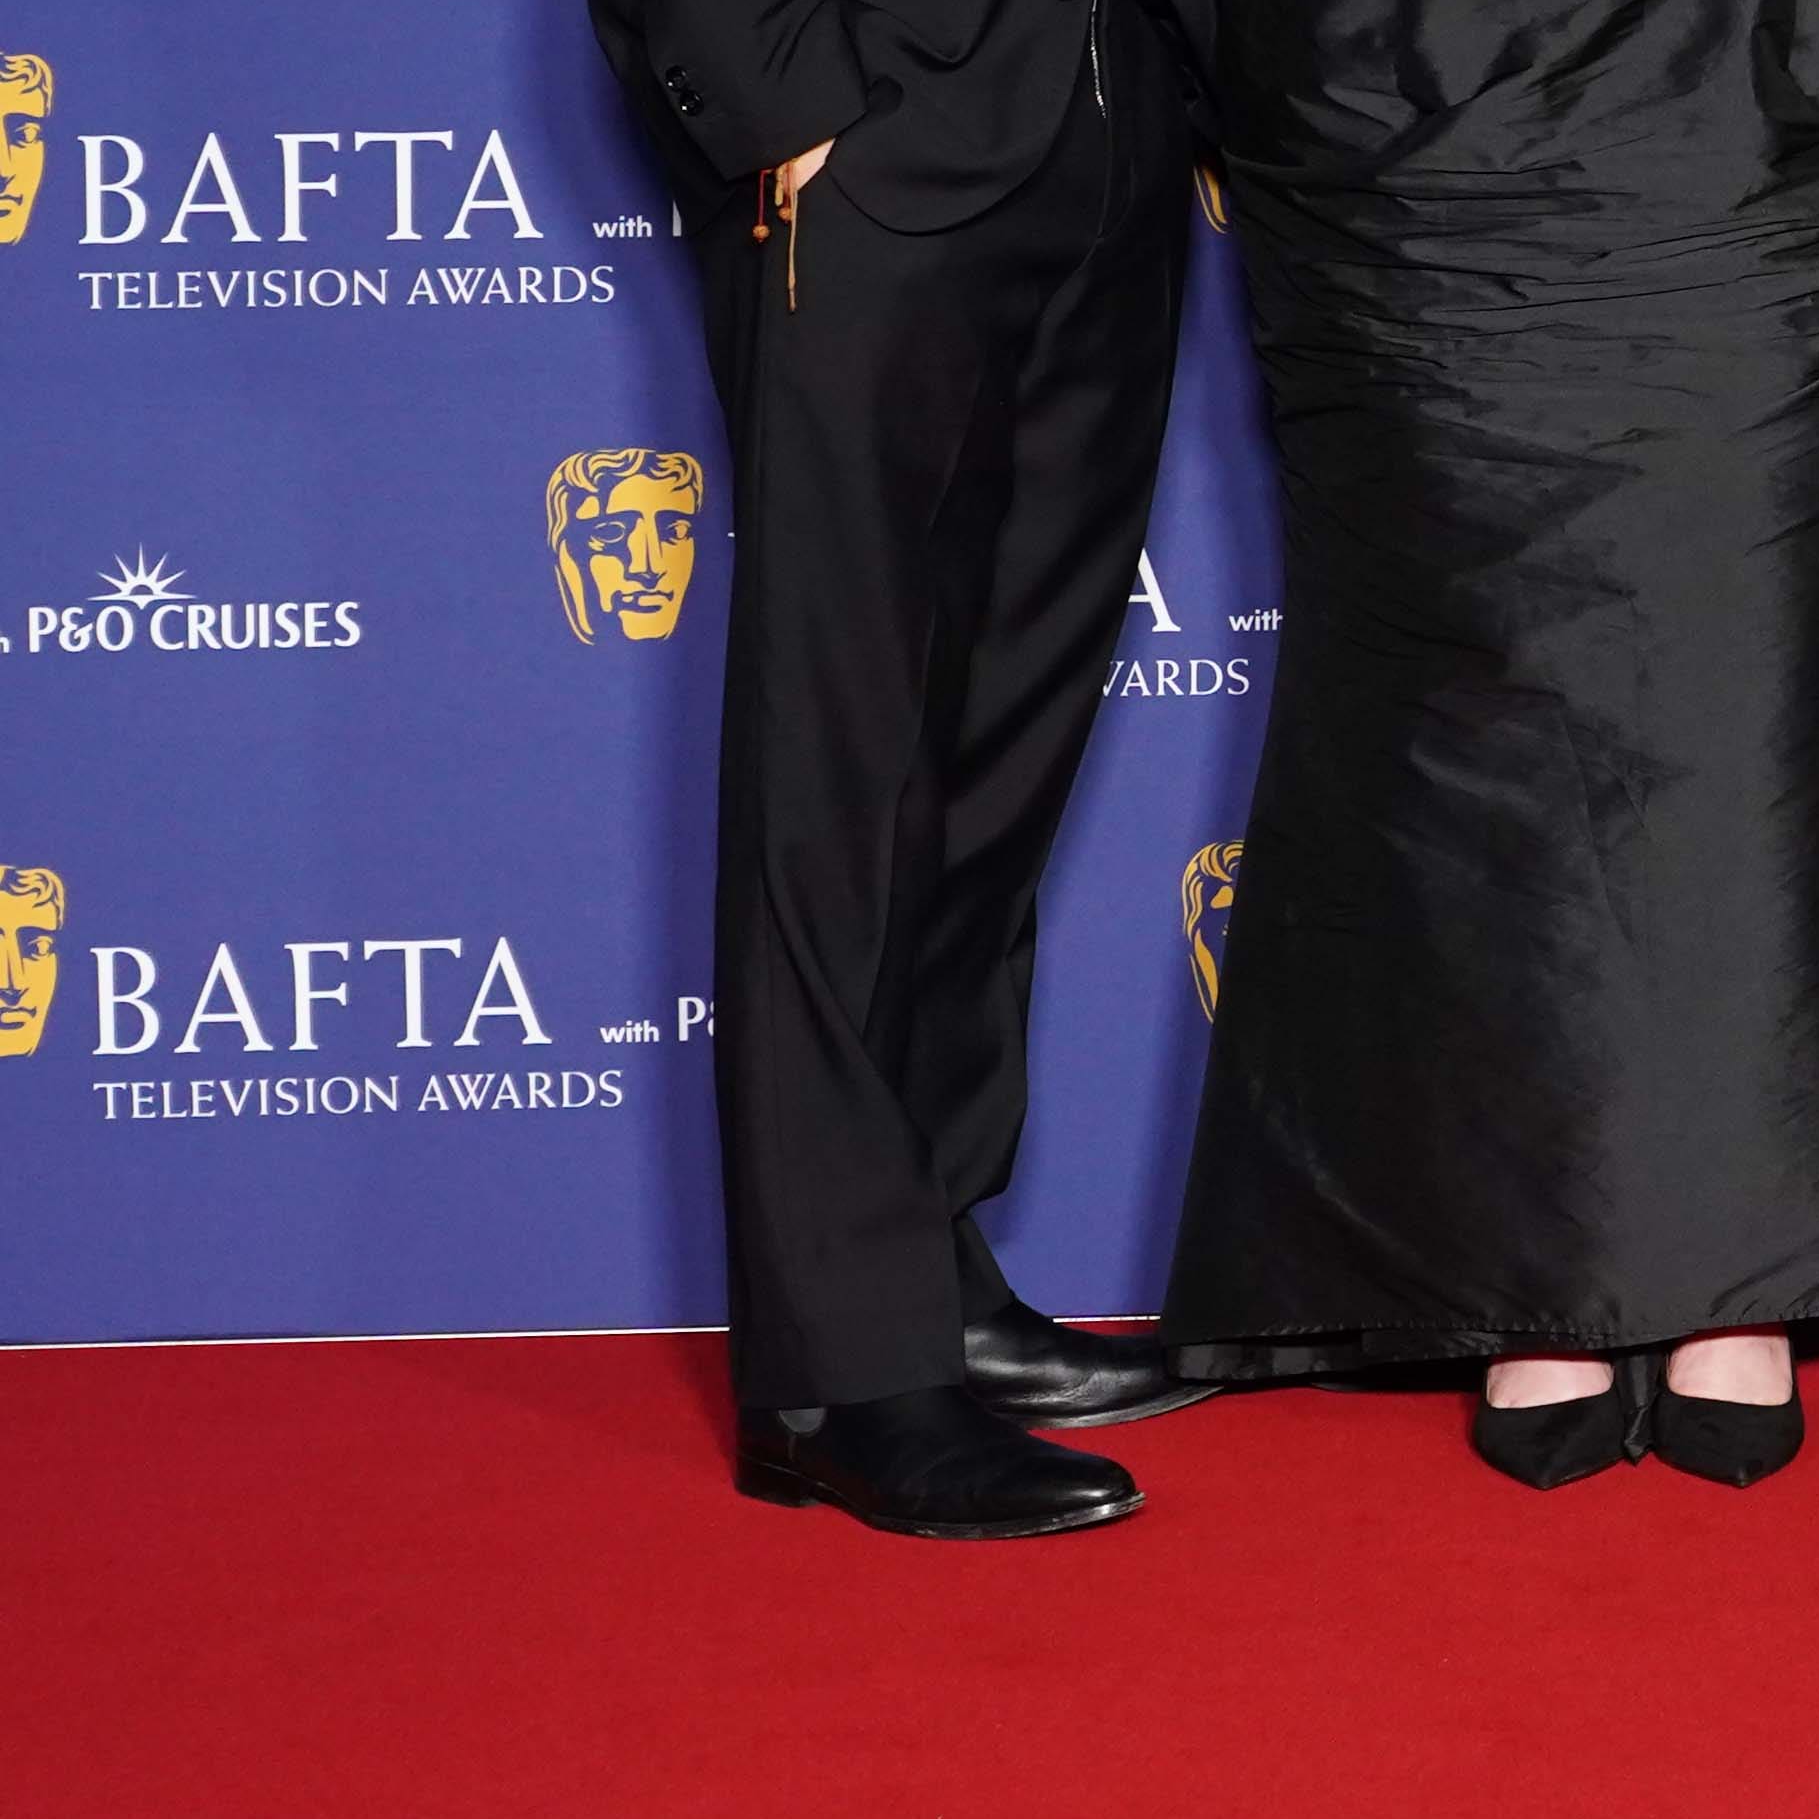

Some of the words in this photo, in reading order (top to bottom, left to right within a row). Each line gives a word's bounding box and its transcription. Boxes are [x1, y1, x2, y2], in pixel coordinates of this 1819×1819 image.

[77, 129, 544, 245] BAFTA
[592, 215, 652, 238] with
[78, 268, 388, 310] TELEVISION
[407, 265, 615, 305] AWARDS
[28, 605, 134, 653] P&O
[150, 602, 360, 649] CRUISES
[1103, 658, 1249, 697] ARDS
[89, 936, 553, 1055] BAFTA
[599, 1020, 660, 1043] with
[93, 1075, 399, 1120] TELEVISION
[417, 1069, 623, 1111] AWARDS
